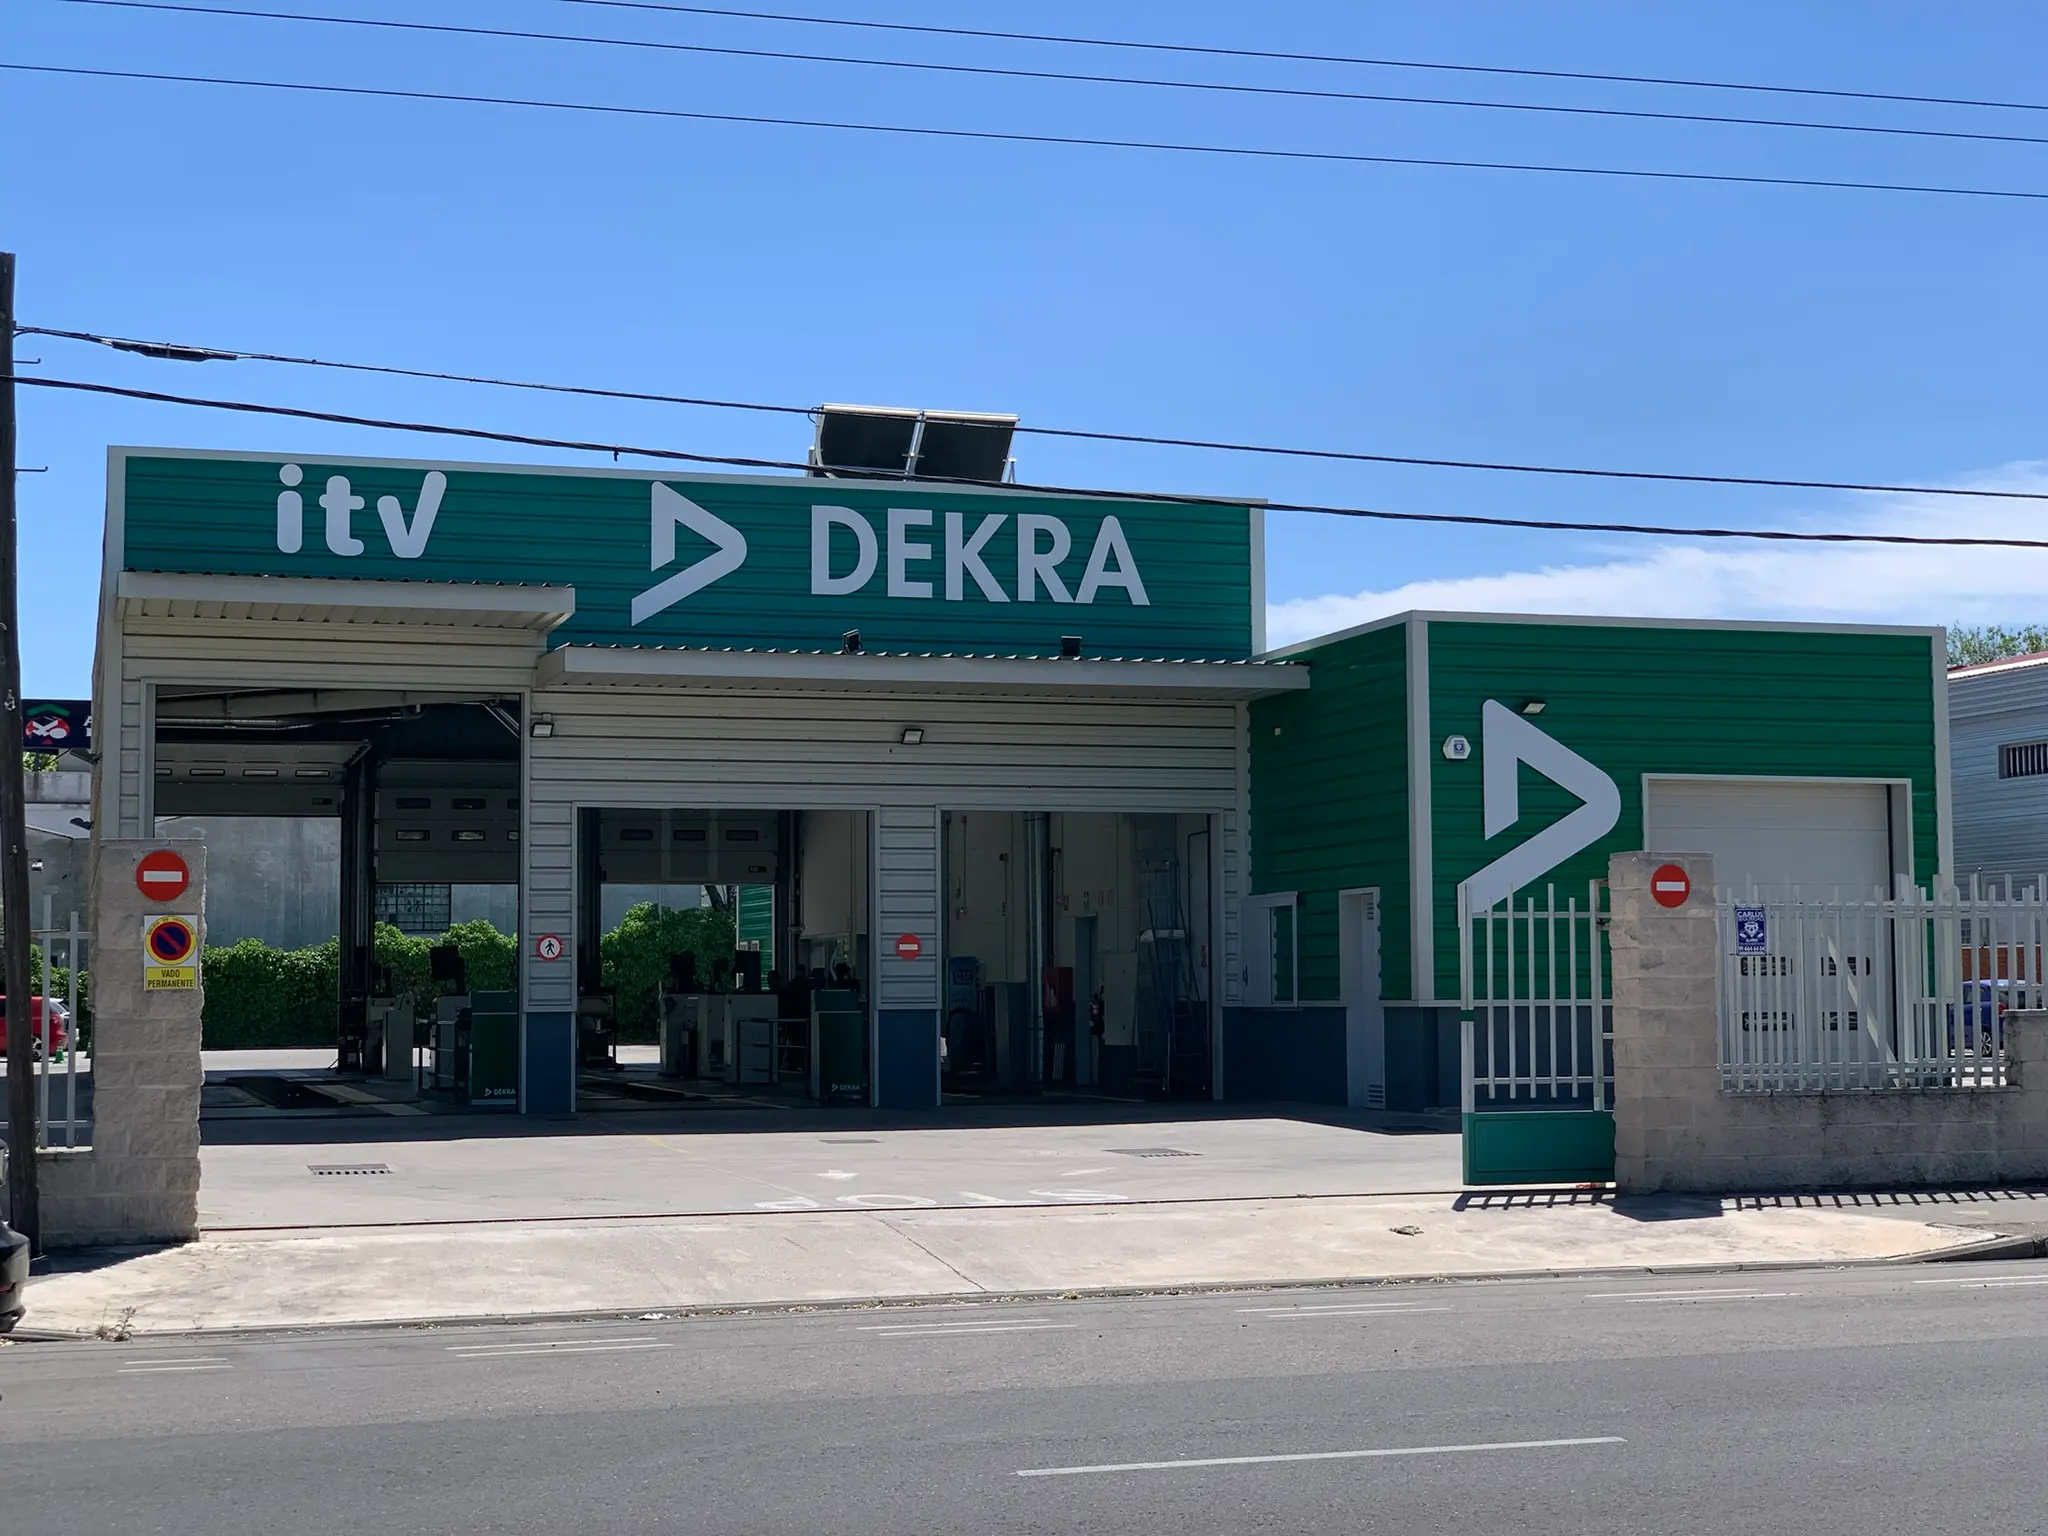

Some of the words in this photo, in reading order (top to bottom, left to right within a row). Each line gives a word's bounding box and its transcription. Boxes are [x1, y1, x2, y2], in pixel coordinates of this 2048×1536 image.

[277, 463, 448, 559] itv
[811, 505, 1151, 606] DEKRA
[147, 980, 194, 988] PERMANENTE
[161, 969, 180, 978] VADO
